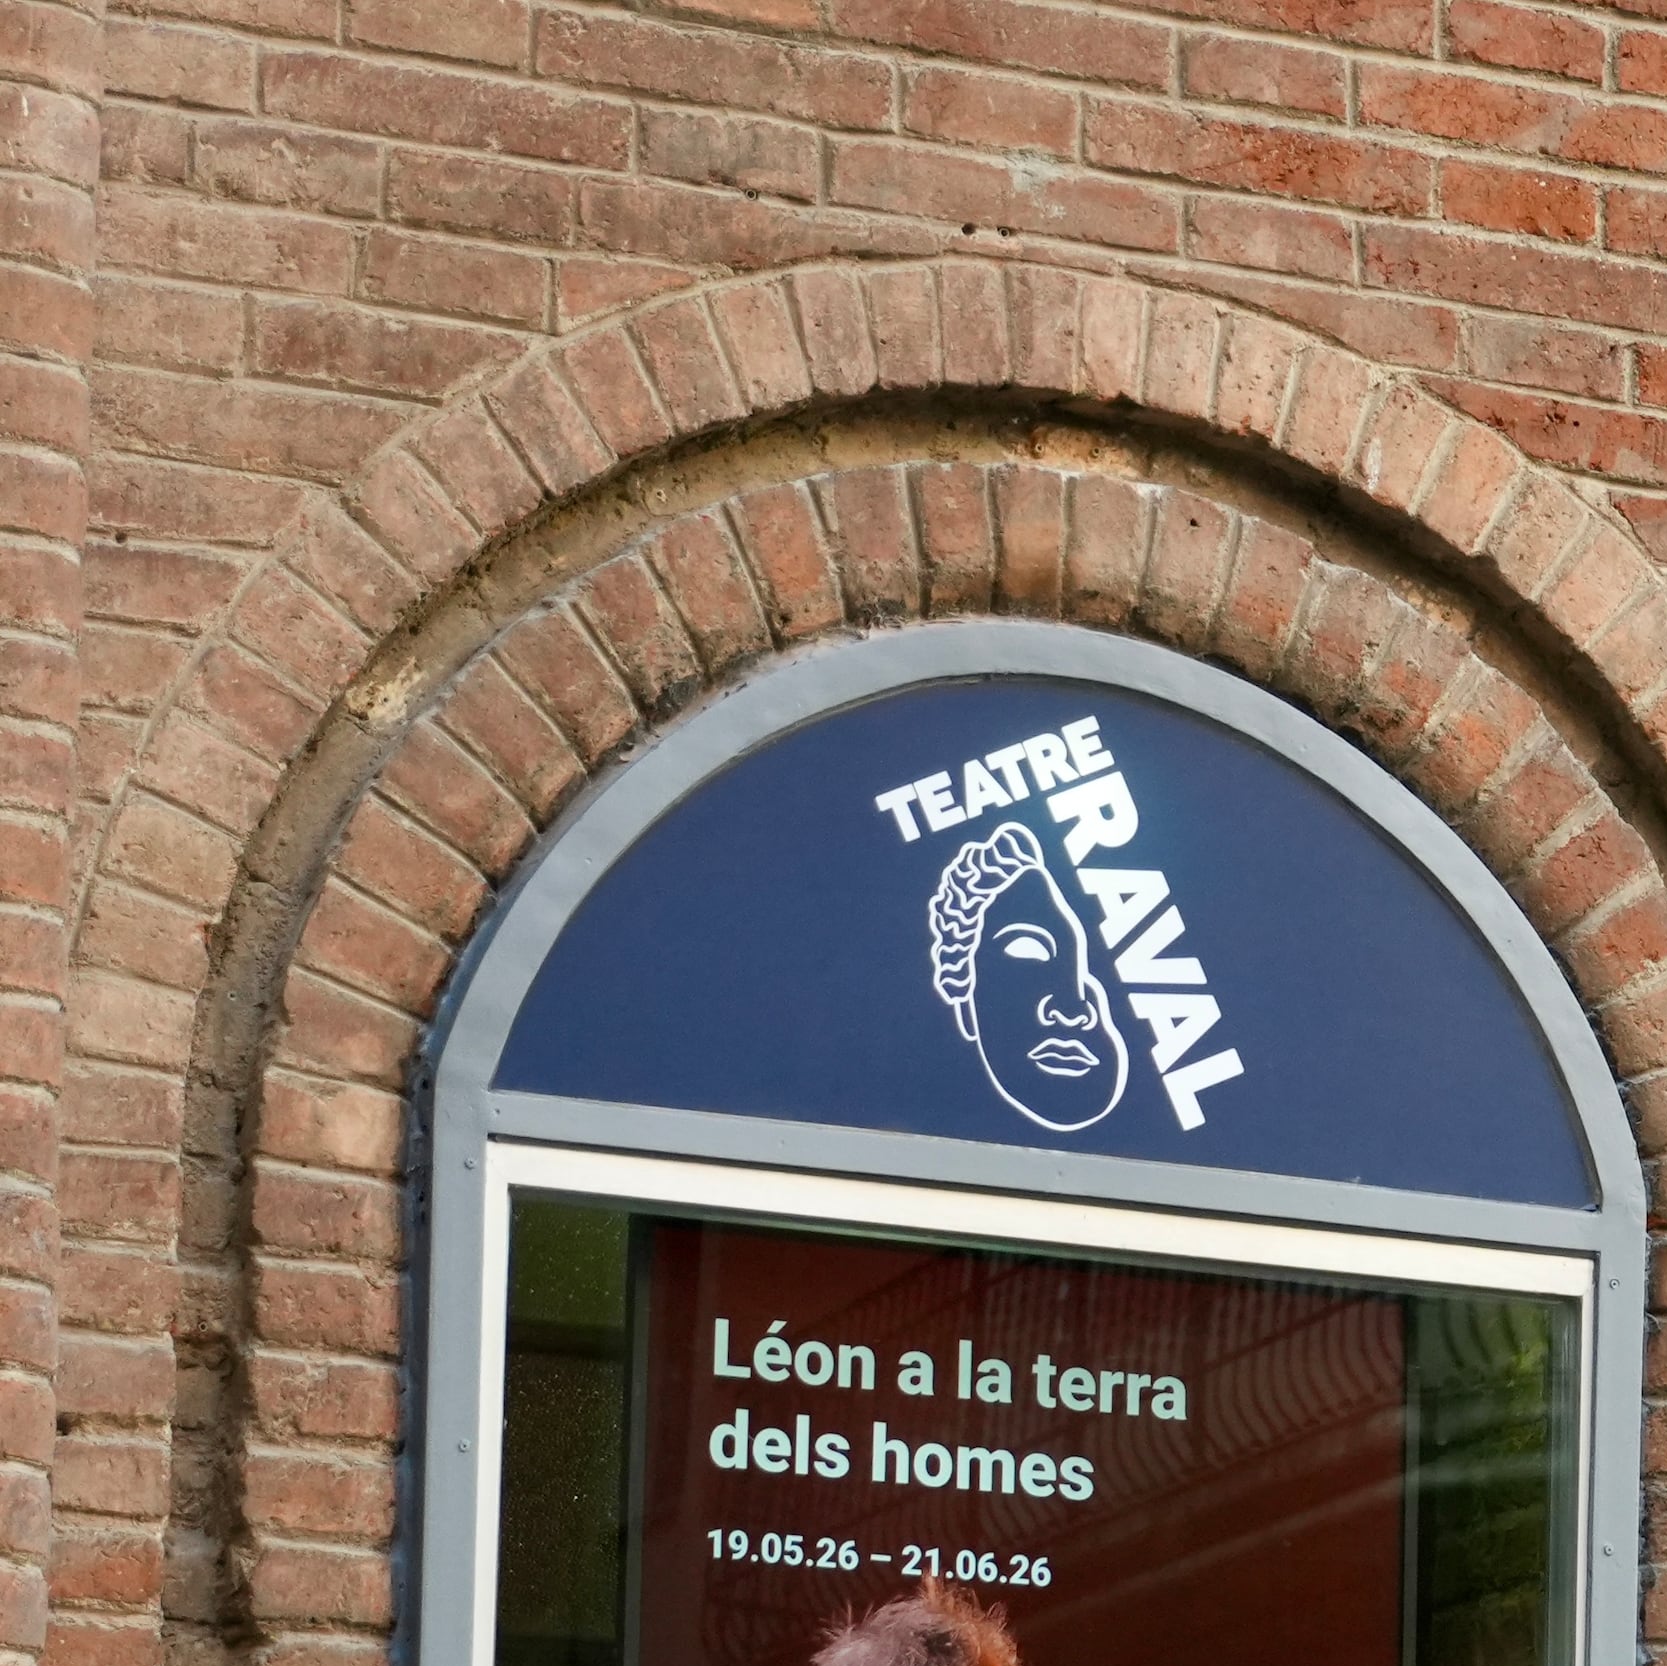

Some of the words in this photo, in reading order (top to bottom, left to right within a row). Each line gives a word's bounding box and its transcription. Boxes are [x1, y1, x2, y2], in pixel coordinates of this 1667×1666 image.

[875, 715, 1117, 842] TEATRE
[1046, 770, 1246, 1132] RAVAL
[712, 1317, 875, 1392] Léon
[897, 1350, 936, 1397] a
[957, 1339, 1012, 1405] la
[1031, 1354, 1188, 1422] terra
[708, 1408, 850, 1480] dels
[871, 1421, 1095, 1502] homes
[707, 1527, 860, 1572] 19.05.26
[901, 1544, 1052, 1588] 21.06.26
